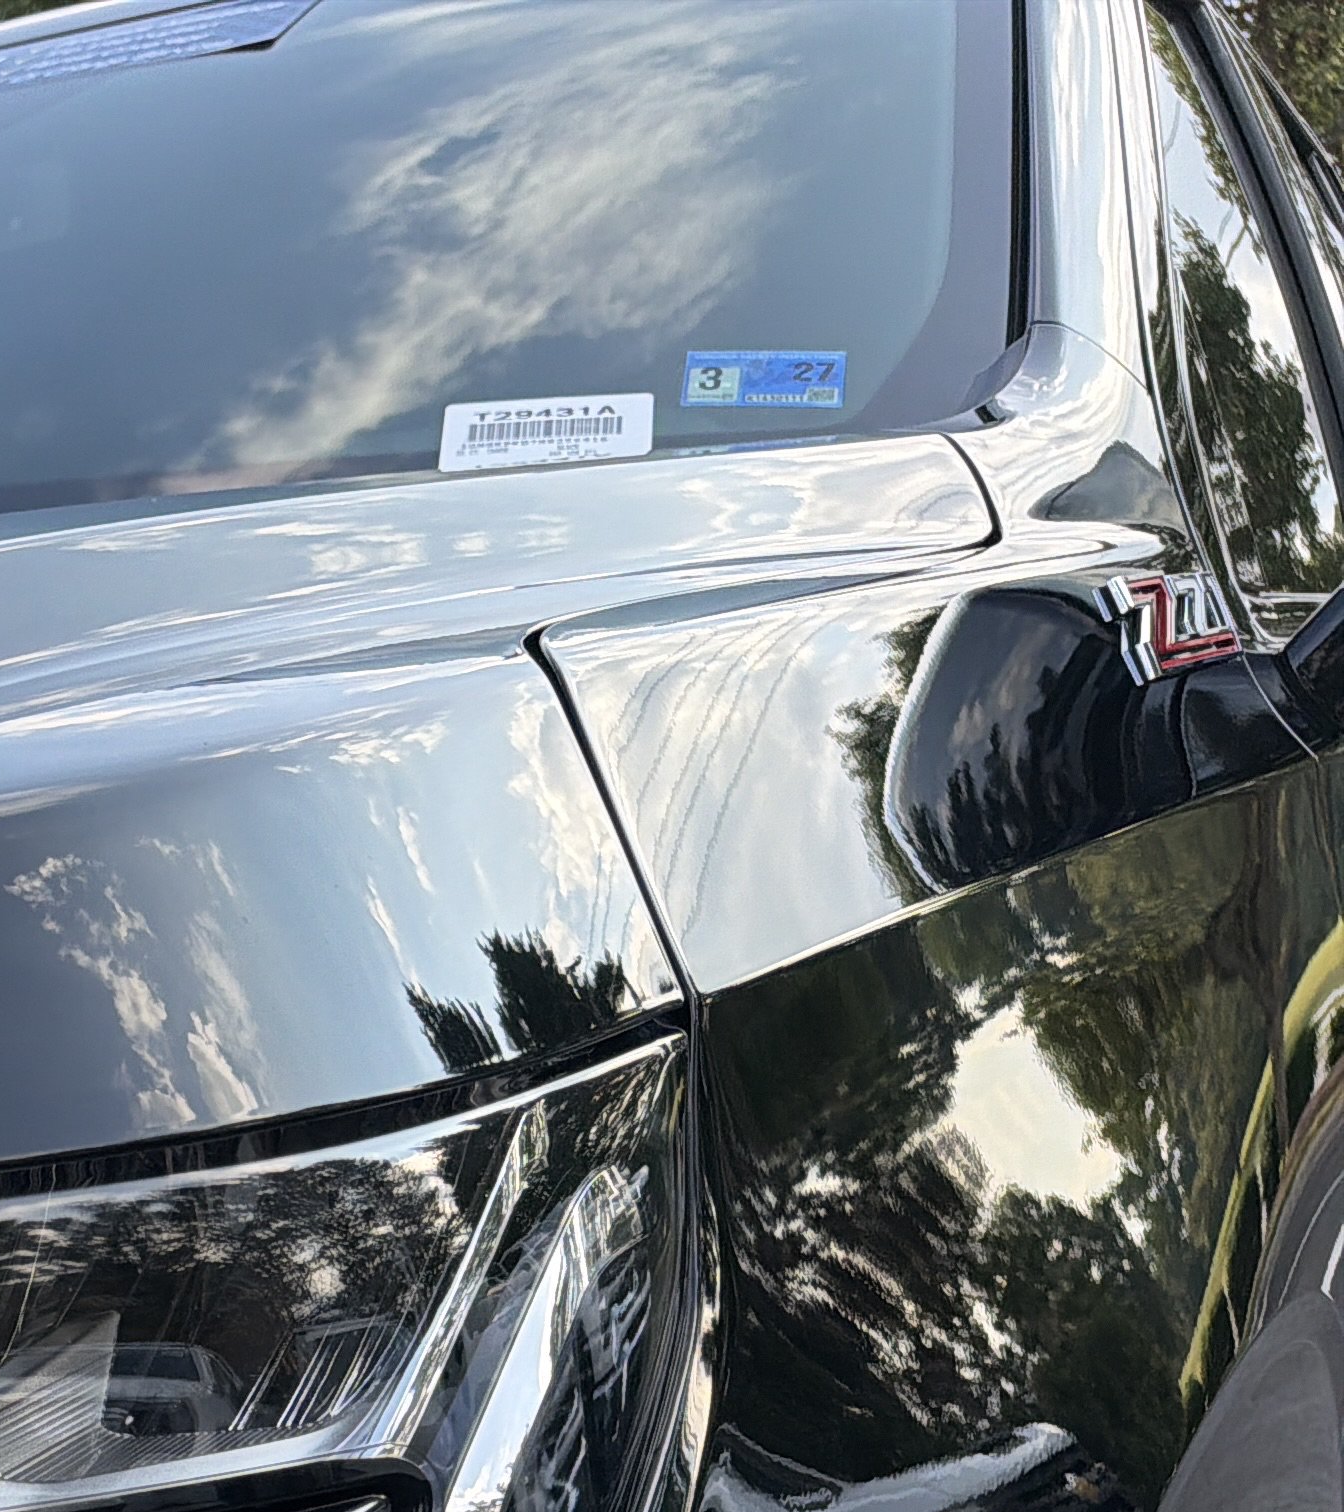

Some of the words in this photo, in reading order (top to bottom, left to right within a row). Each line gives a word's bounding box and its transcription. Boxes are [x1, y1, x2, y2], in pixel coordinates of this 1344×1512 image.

[698, 367, 723, 391] 3
[793, 361, 836, 382] 27
[473, 405, 616, 423] T29431A
